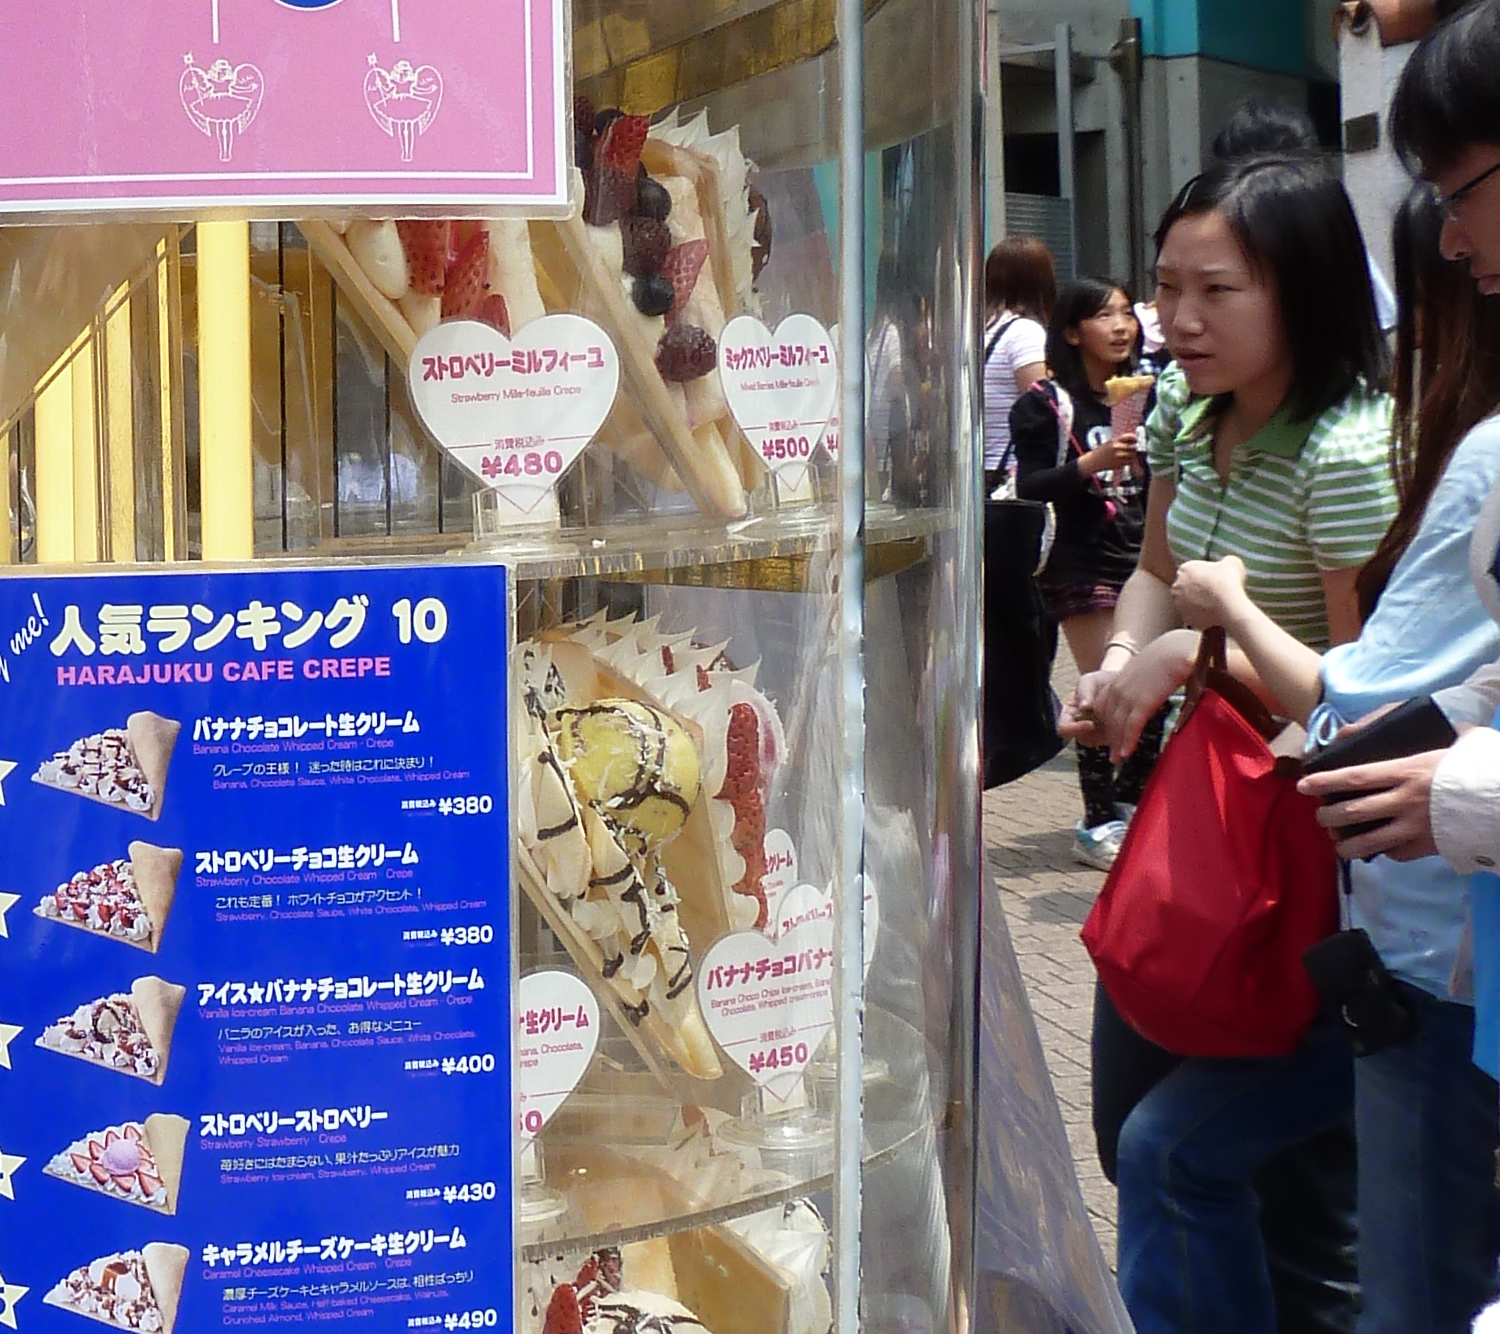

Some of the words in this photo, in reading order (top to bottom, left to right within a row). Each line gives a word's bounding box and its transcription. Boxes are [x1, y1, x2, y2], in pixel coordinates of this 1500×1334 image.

[421, 346, 606, 384] ストロベリーミルフィーユ
[724, 344, 830, 372] ミックスベリーミルフィーユ
[451, 389, 501, 405] Strawberry
[761, 435, 811, 461] ¥500
[480, 450, 564, 480] ¥480
[49, 594, 367, 658] 人気ランキング
[391, 596, 448, 645] 10
[56, 662, 215, 687] HARAJUKU
[222, 659, 294, 683] CAFE
[303, 656, 392, 680] CREPE
[193, 710, 421, 742] バナナチョコレート生クリーム
[438, 795, 493, 816] ¥380
[195, 842, 419, 874] ストロベリーチョコ生クリーム
[440, 925, 494, 946] ¥380
[198, 968, 485, 1006] アイス★バナナチョコレート生クリーム
[441, 1053, 496, 1075] ¥400
[748, 1042, 809, 1073] ¥450
[200, 1105, 388, 1136] ストロベリーストロベリー
[443, 1182, 497, 1205] ¥430
[202, 1227, 467, 1267] キャラメルチーズケーキ生クリーム
[444, 1308, 498, 1332] ¥490
